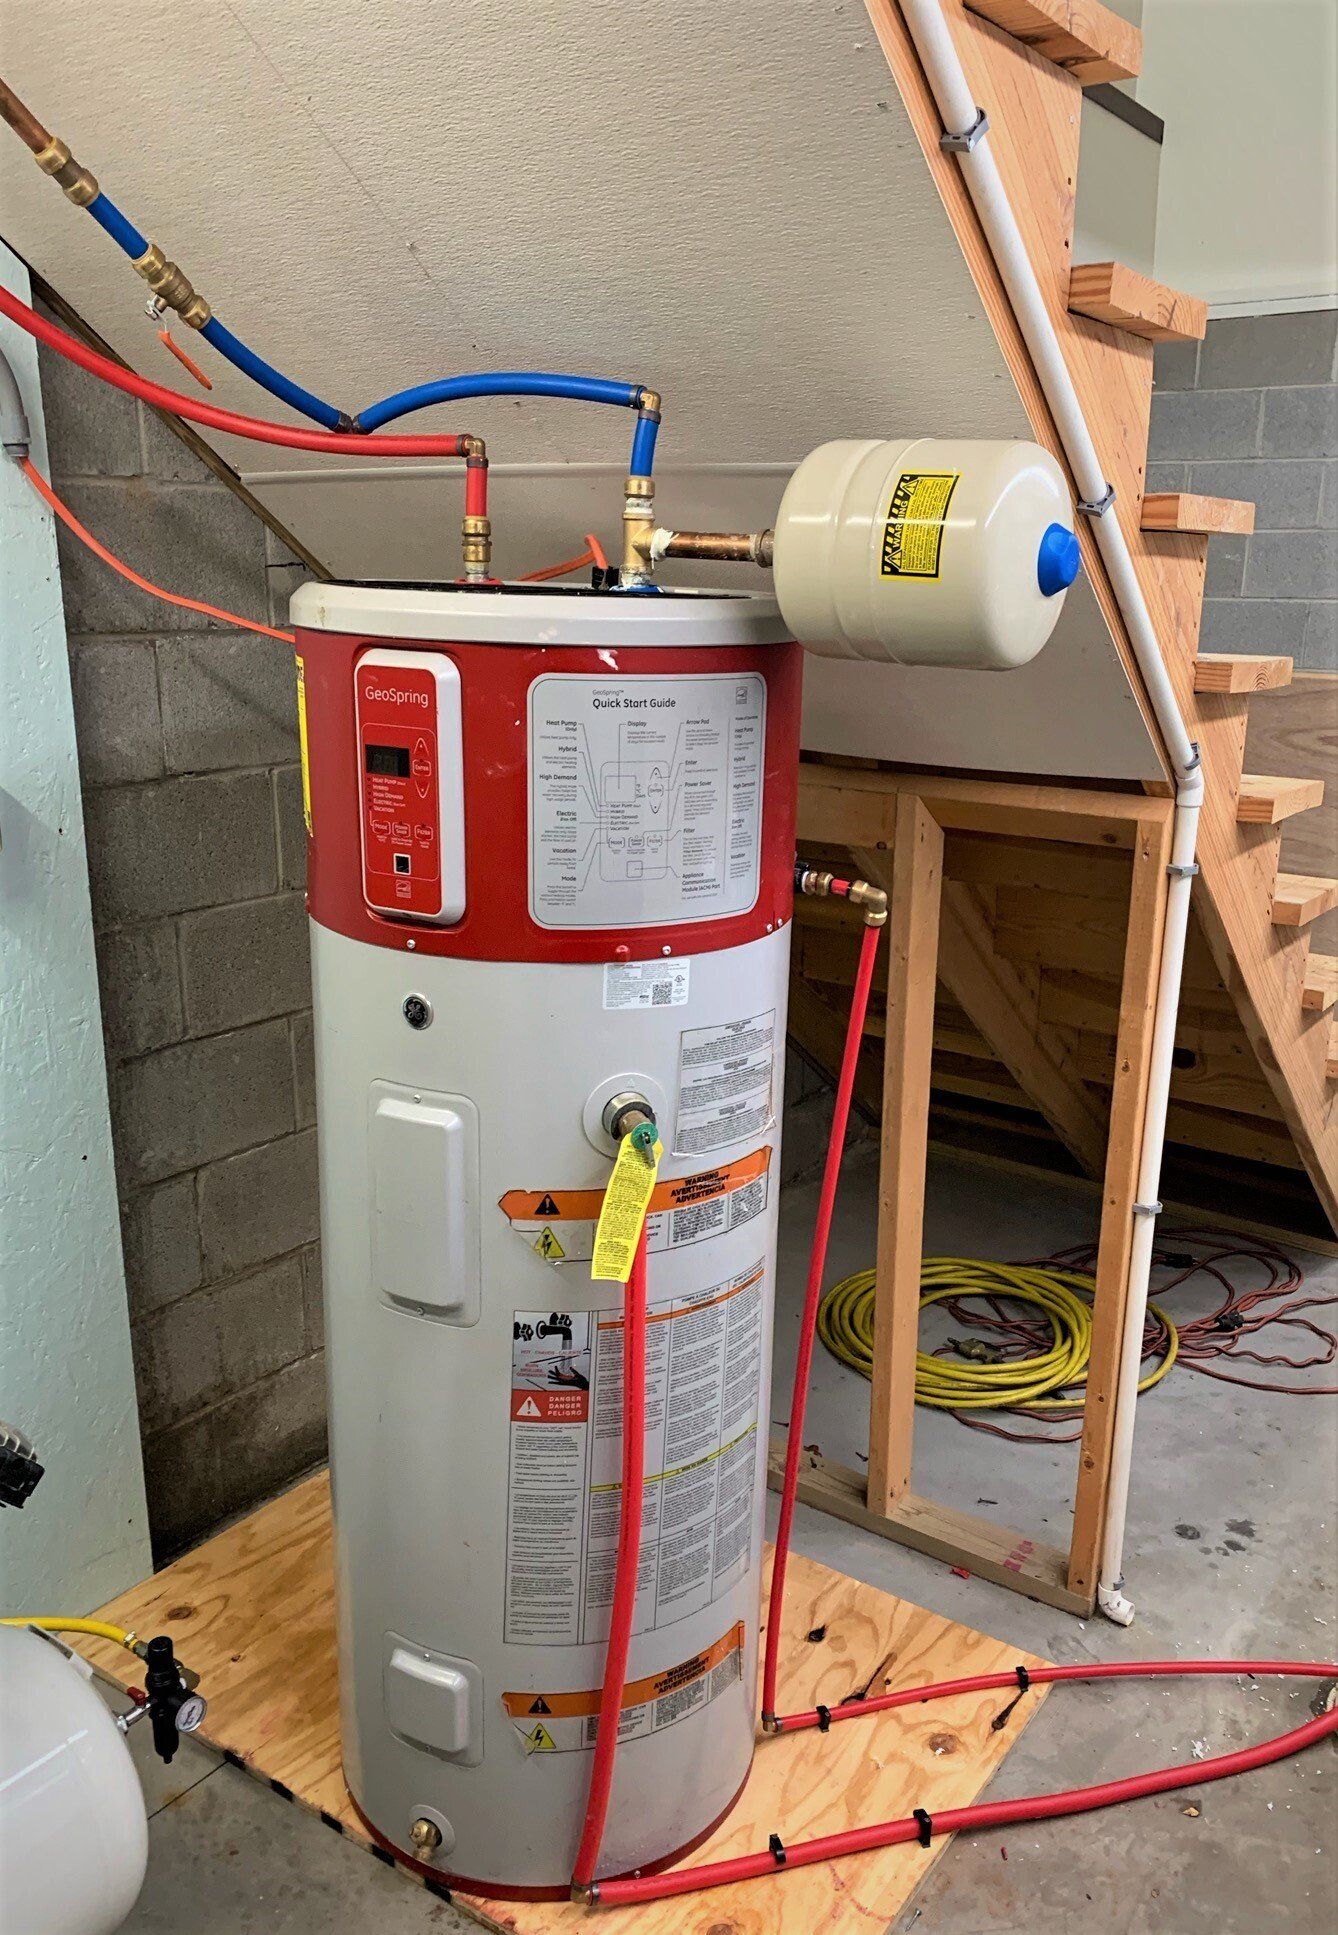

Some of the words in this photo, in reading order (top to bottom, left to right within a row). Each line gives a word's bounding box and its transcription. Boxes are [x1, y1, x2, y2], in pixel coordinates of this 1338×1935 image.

[893, 501, 908, 548] WARING
[366, 686, 428, 708] GeoSpring
[592, 698, 621, 710] Quick
[624, 698, 648, 708] Start
[650, 698, 676, 708] Guide
[684, 1171, 719, 1186] WARNING
[676, 1183, 725, 1203] ADVERTENCIA
[667, 1657, 699, 1678] WARNING
